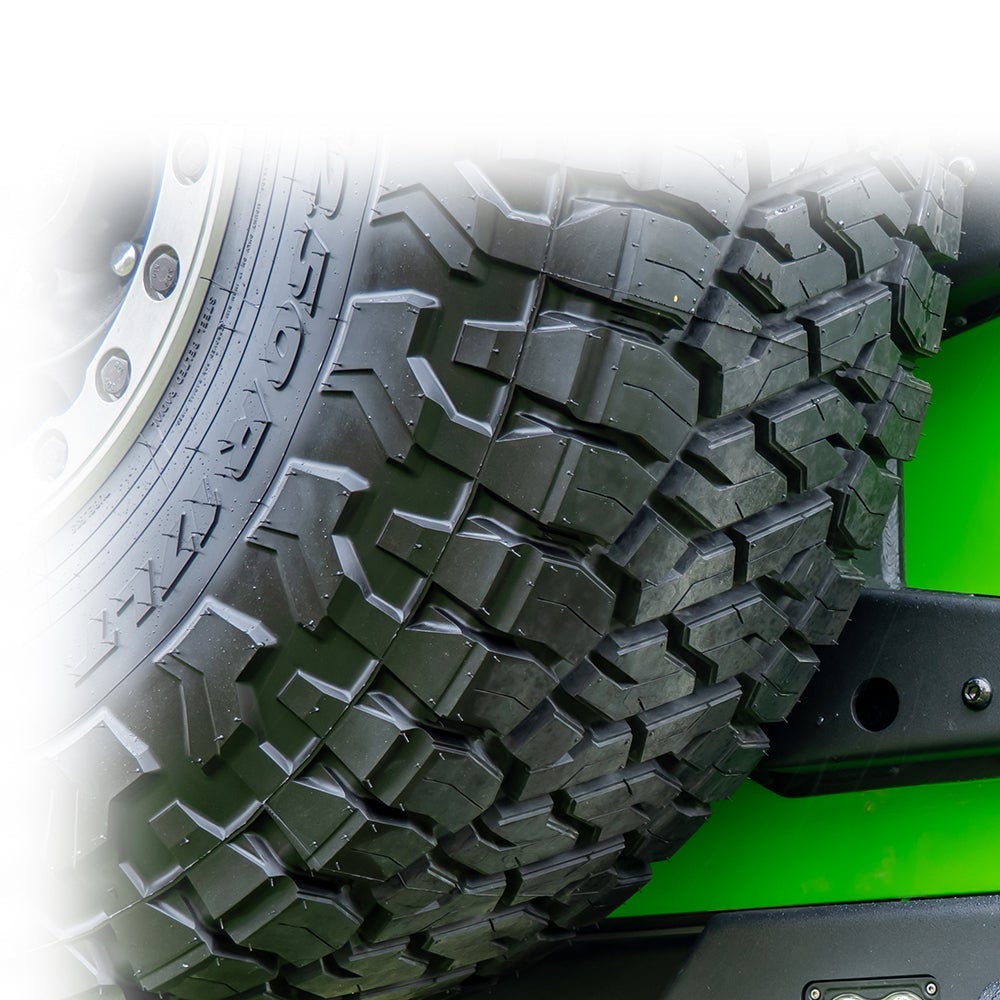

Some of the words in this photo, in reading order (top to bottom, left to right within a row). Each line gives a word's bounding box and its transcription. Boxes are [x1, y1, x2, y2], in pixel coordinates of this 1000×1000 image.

[196, 296, 216, 333] STEEL
[174, 341, 200, 386] BELTED
[150, 389, 177, 428] RADIAL
